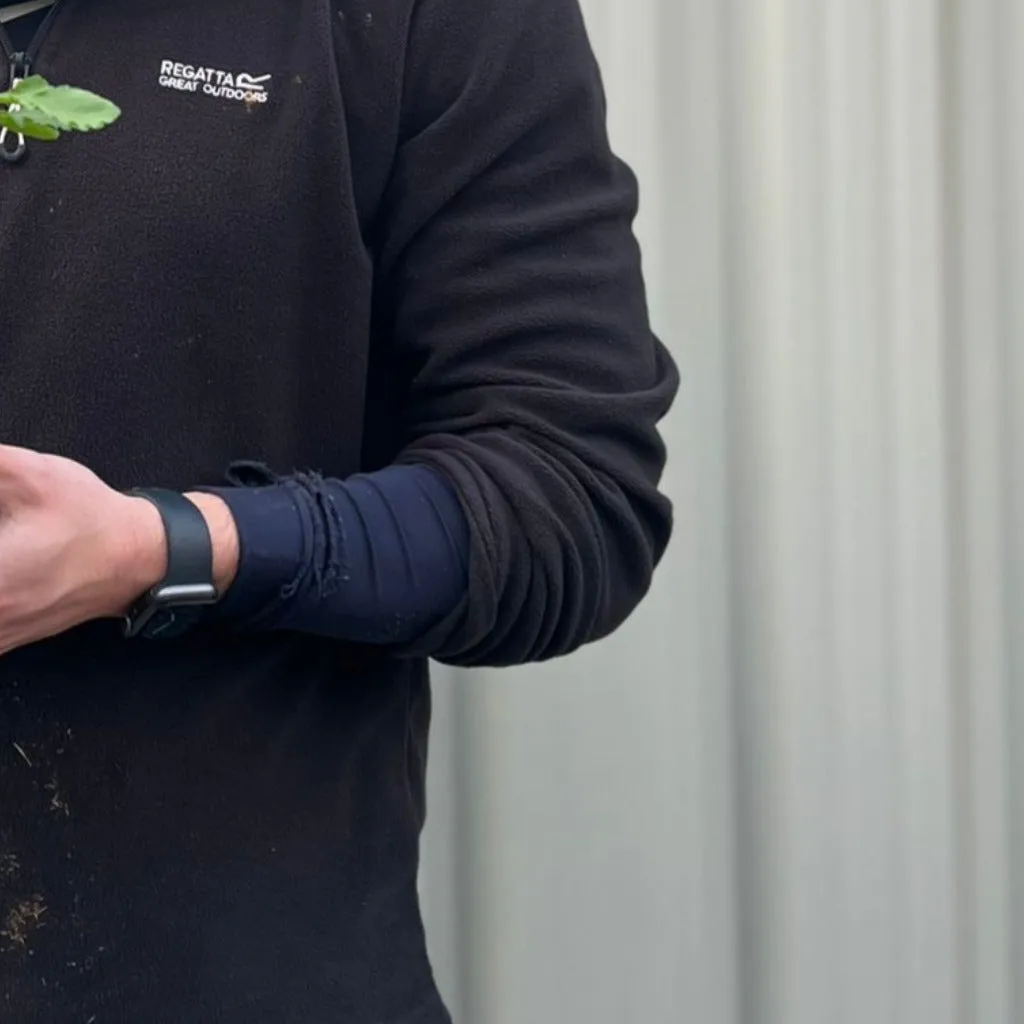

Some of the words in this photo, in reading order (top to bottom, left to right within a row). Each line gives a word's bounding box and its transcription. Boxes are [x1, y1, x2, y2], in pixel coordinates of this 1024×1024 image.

[160, 59, 234, 87] REGATTA
[158, 75, 199, 92] GREAT
[202, 83, 268, 103] OUTDOORS
